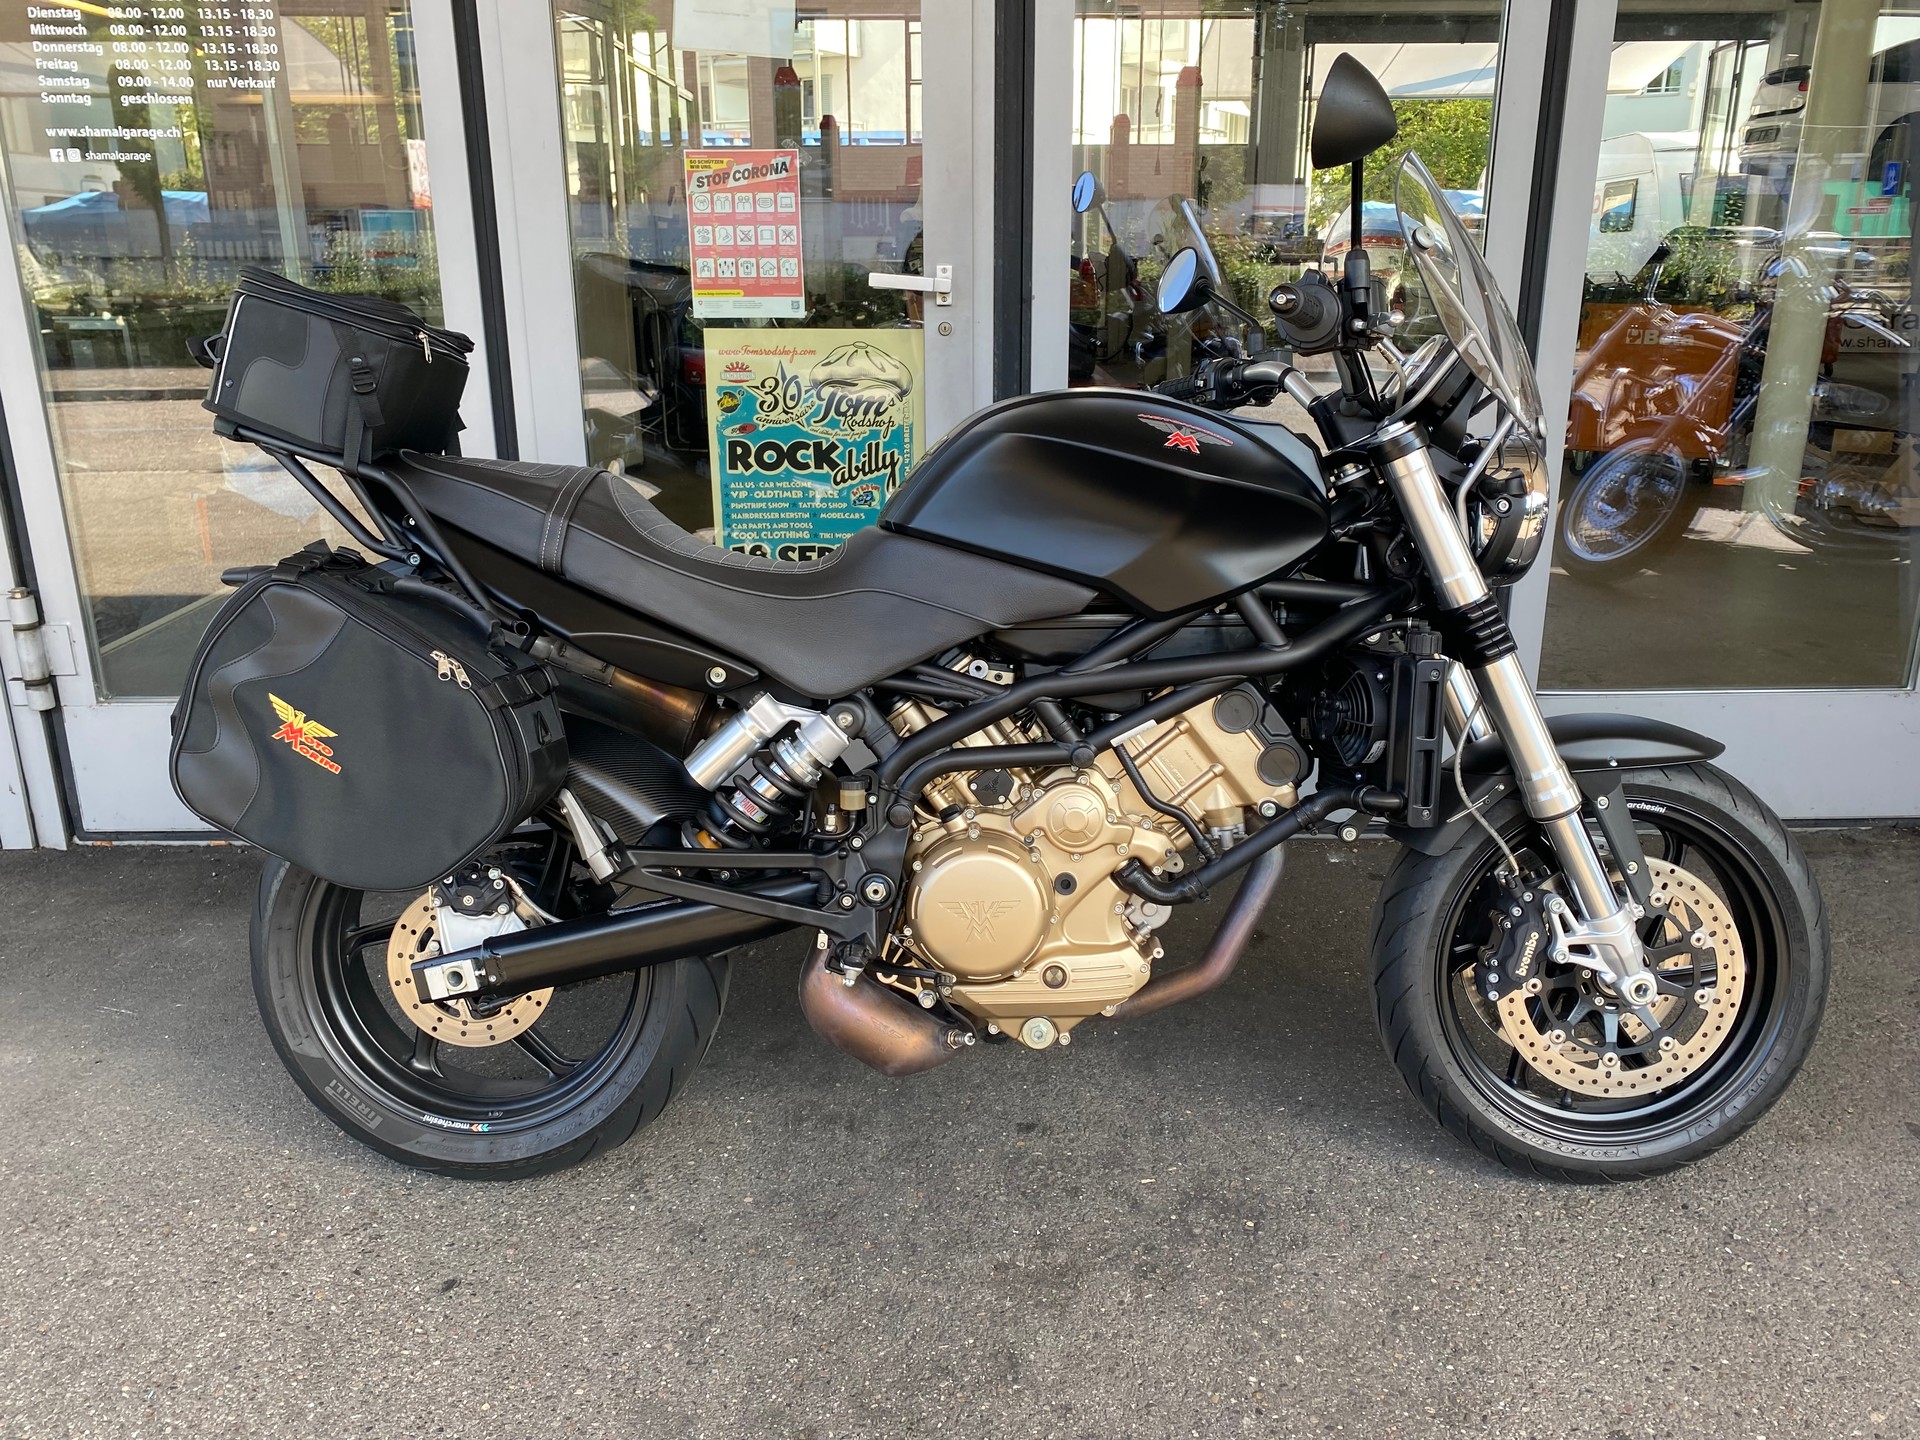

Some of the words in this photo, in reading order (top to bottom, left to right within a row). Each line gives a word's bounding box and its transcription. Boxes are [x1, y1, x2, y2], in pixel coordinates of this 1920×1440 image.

[28, 7, 81, 20] Dienstag
[107, 8, 141, 18] 08.00
[151, 8, 184, 19] 12.00
[198, 8, 230, 19] 13.15
[240, 9, 273, 19] 18.30
[30, 24, 86, 36] Mittwoch
[110, 25, 143, 36] 08.00
[153, 25, 186, 36] 12.00
[200, 26, 233, 37] 13.15
[243, 26, 275, 37] 18.30
[33, 41, 103, 56] Donnerstag
[113, 42, 146, 53] 08.00
[156, 43, 189, 54] 12.00
[202, 43, 235, 54] 13.15
[245, 44, 278, 55] 18.30
[35, 58, 78, 72] Freitag
[115, 60, 149, 70] 08.00
[158, 60, 191, 71] 12.00
[205, 60, 237, 71] 13.15
[247, 61, 280, 72] 18.30
[38, 75, 90, 88] Samstag
[118, 77, 151, 87] 09.00
[161, 77, 194, 88] 14.00
[207, 79, 227, 88] nur
[229, 77, 275, 89] Verkauf
[41, 93, 91, 105] Sonntag
[121, 94, 193, 106] geschlossen
[46, 126, 180, 141] www.shamalgarage.ch
[85, 151, 151, 162] shamalgarage
[696, 172, 730, 188] STOP
[732, 161, 788, 182] CORONA
[759, 375, 802, 413] 30
[755, 400, 815, 425] anniversaire
[843, 414, 896, 439] Rodshop
[733, 531, 759, 539] COOL
[761, 531, 810, 539] CLOTHING
[1626, 802, 1667, 814] archesini
[1515, 932, 1539, 976] brembo
[324, 1080, 384, 1130] PIRELLI
[420, 1114, 470, 1130] marchesini
